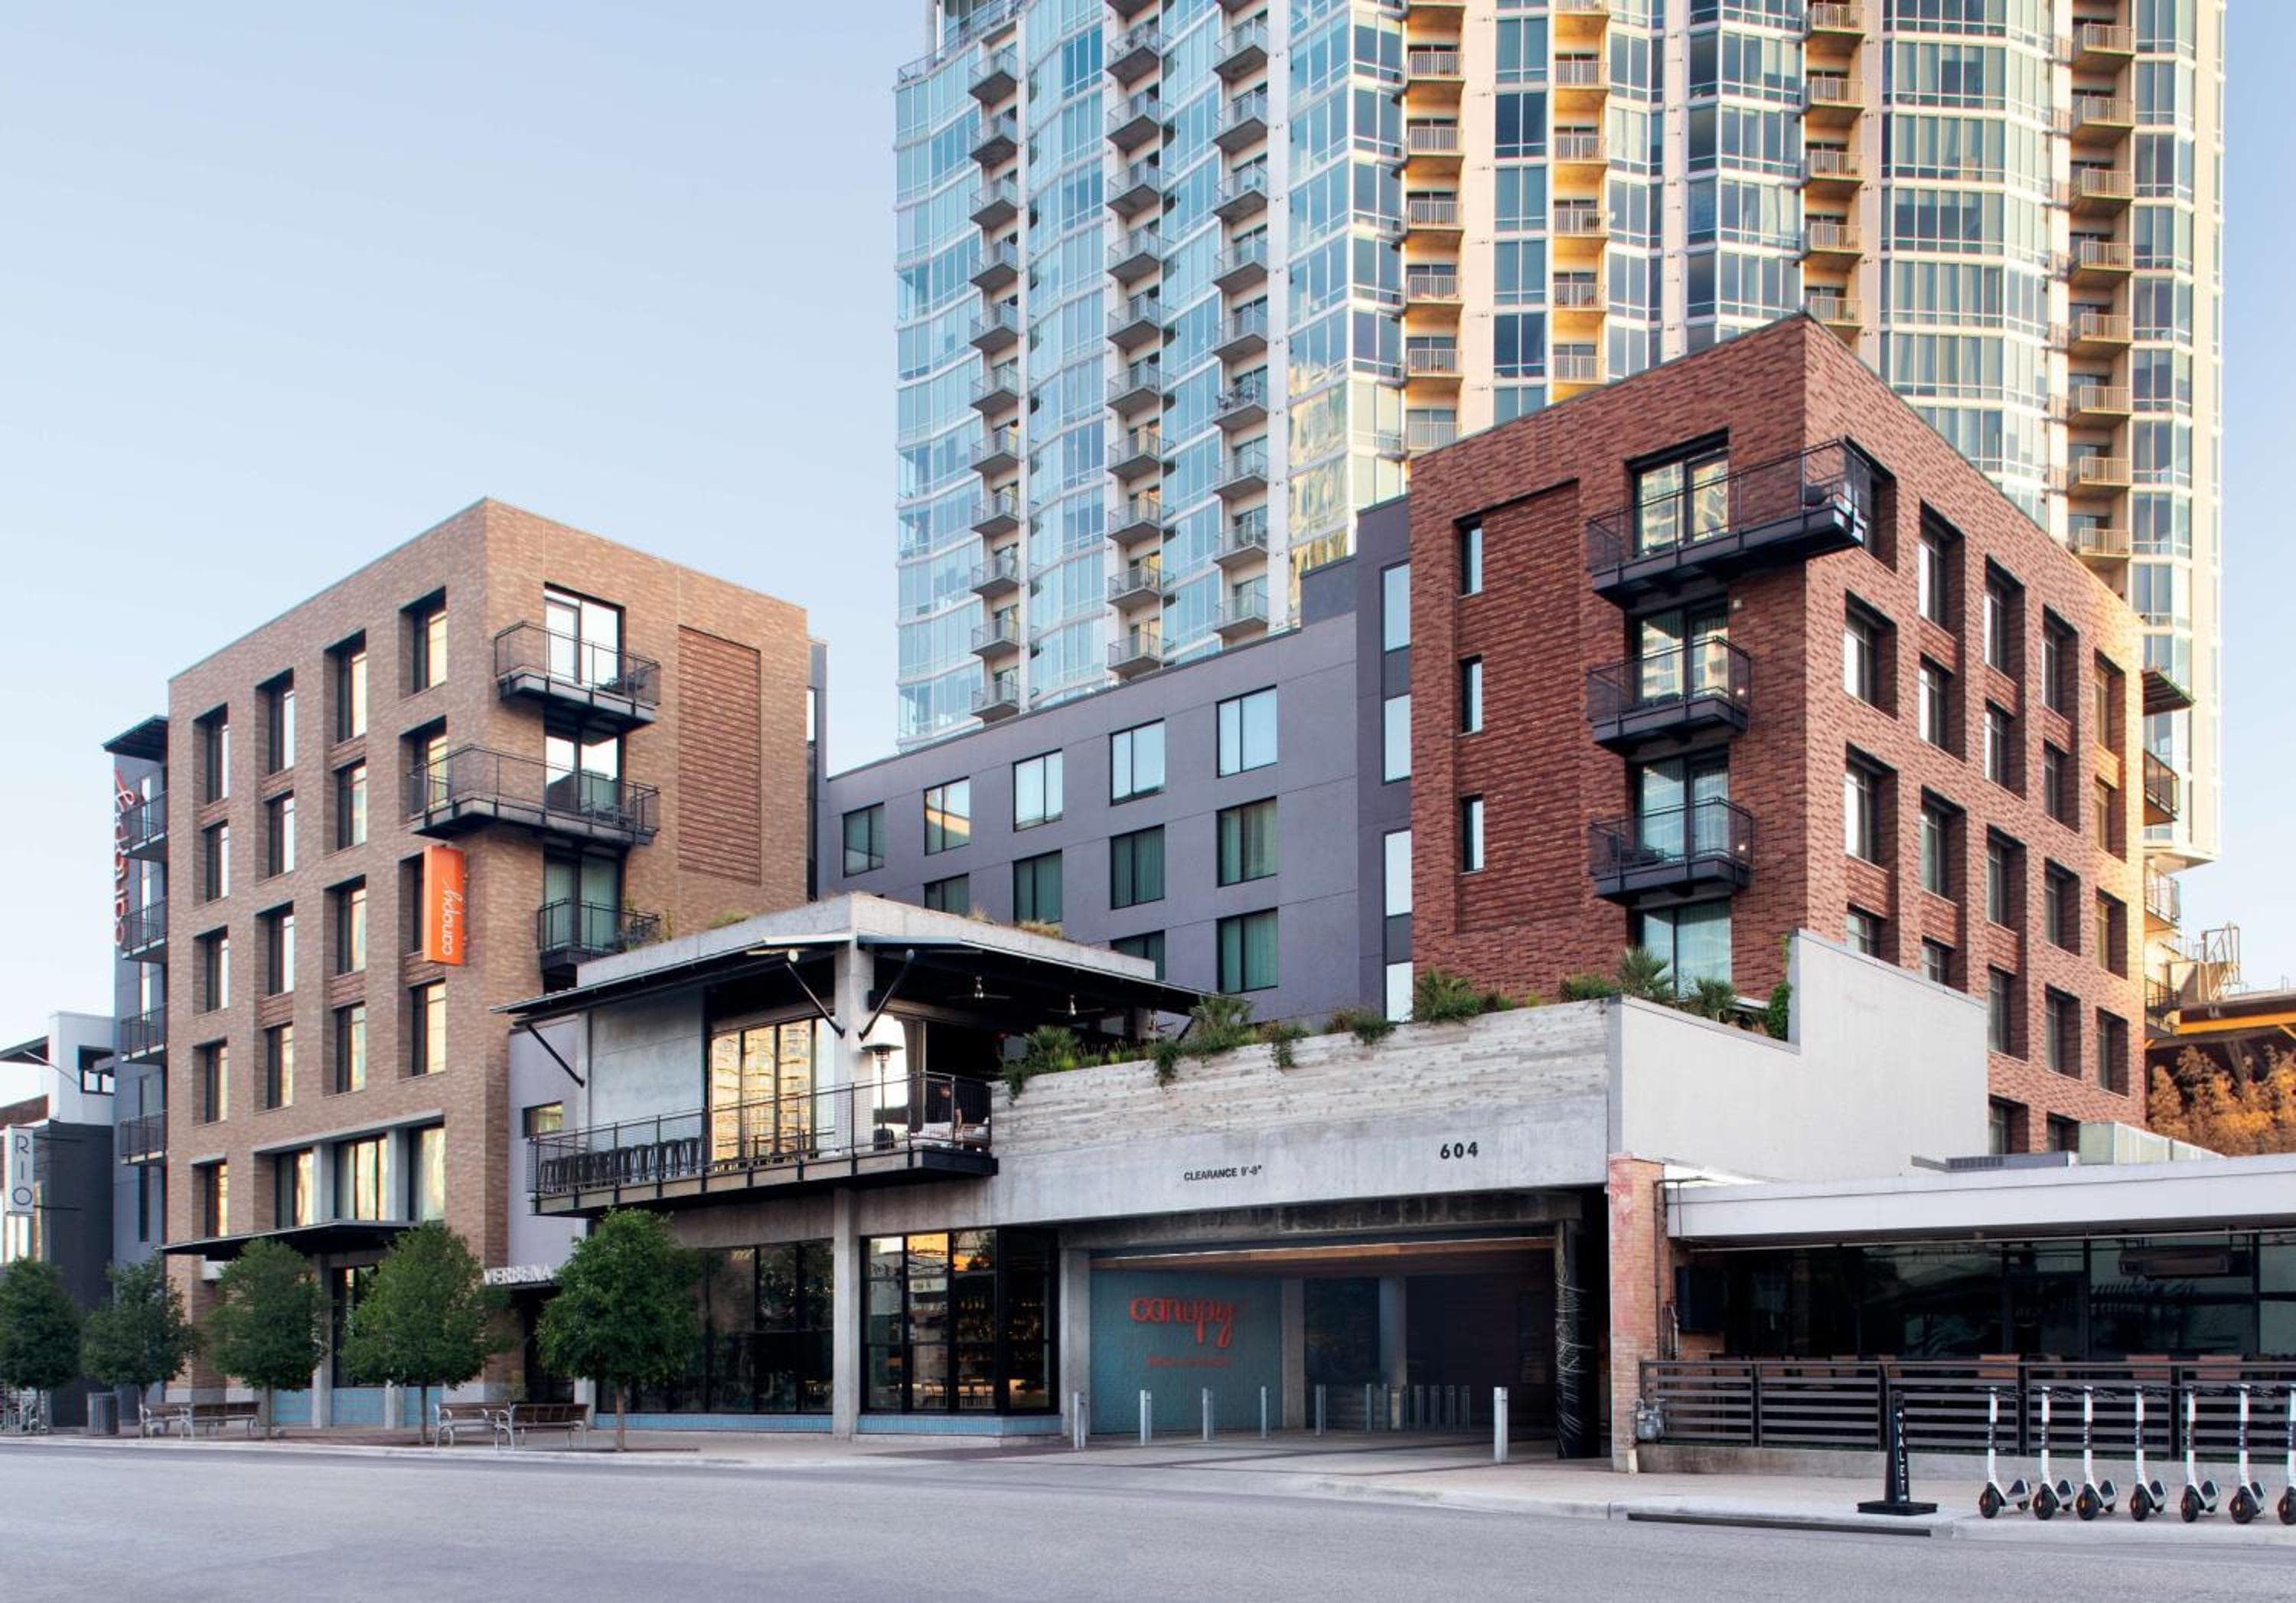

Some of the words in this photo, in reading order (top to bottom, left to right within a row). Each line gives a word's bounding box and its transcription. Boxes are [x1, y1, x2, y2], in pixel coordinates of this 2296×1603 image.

[433, 877, 464, 956] canopy
[12, 1135, 32, 1206] RIO
[1183, 1167, 1238, 1181] CLEARANCE
[1440, 1141, 1478, 1160] 604
[1129, 1297, 1238, 1349] canopy
[1896, 1421, 1906, 1492] VALET
